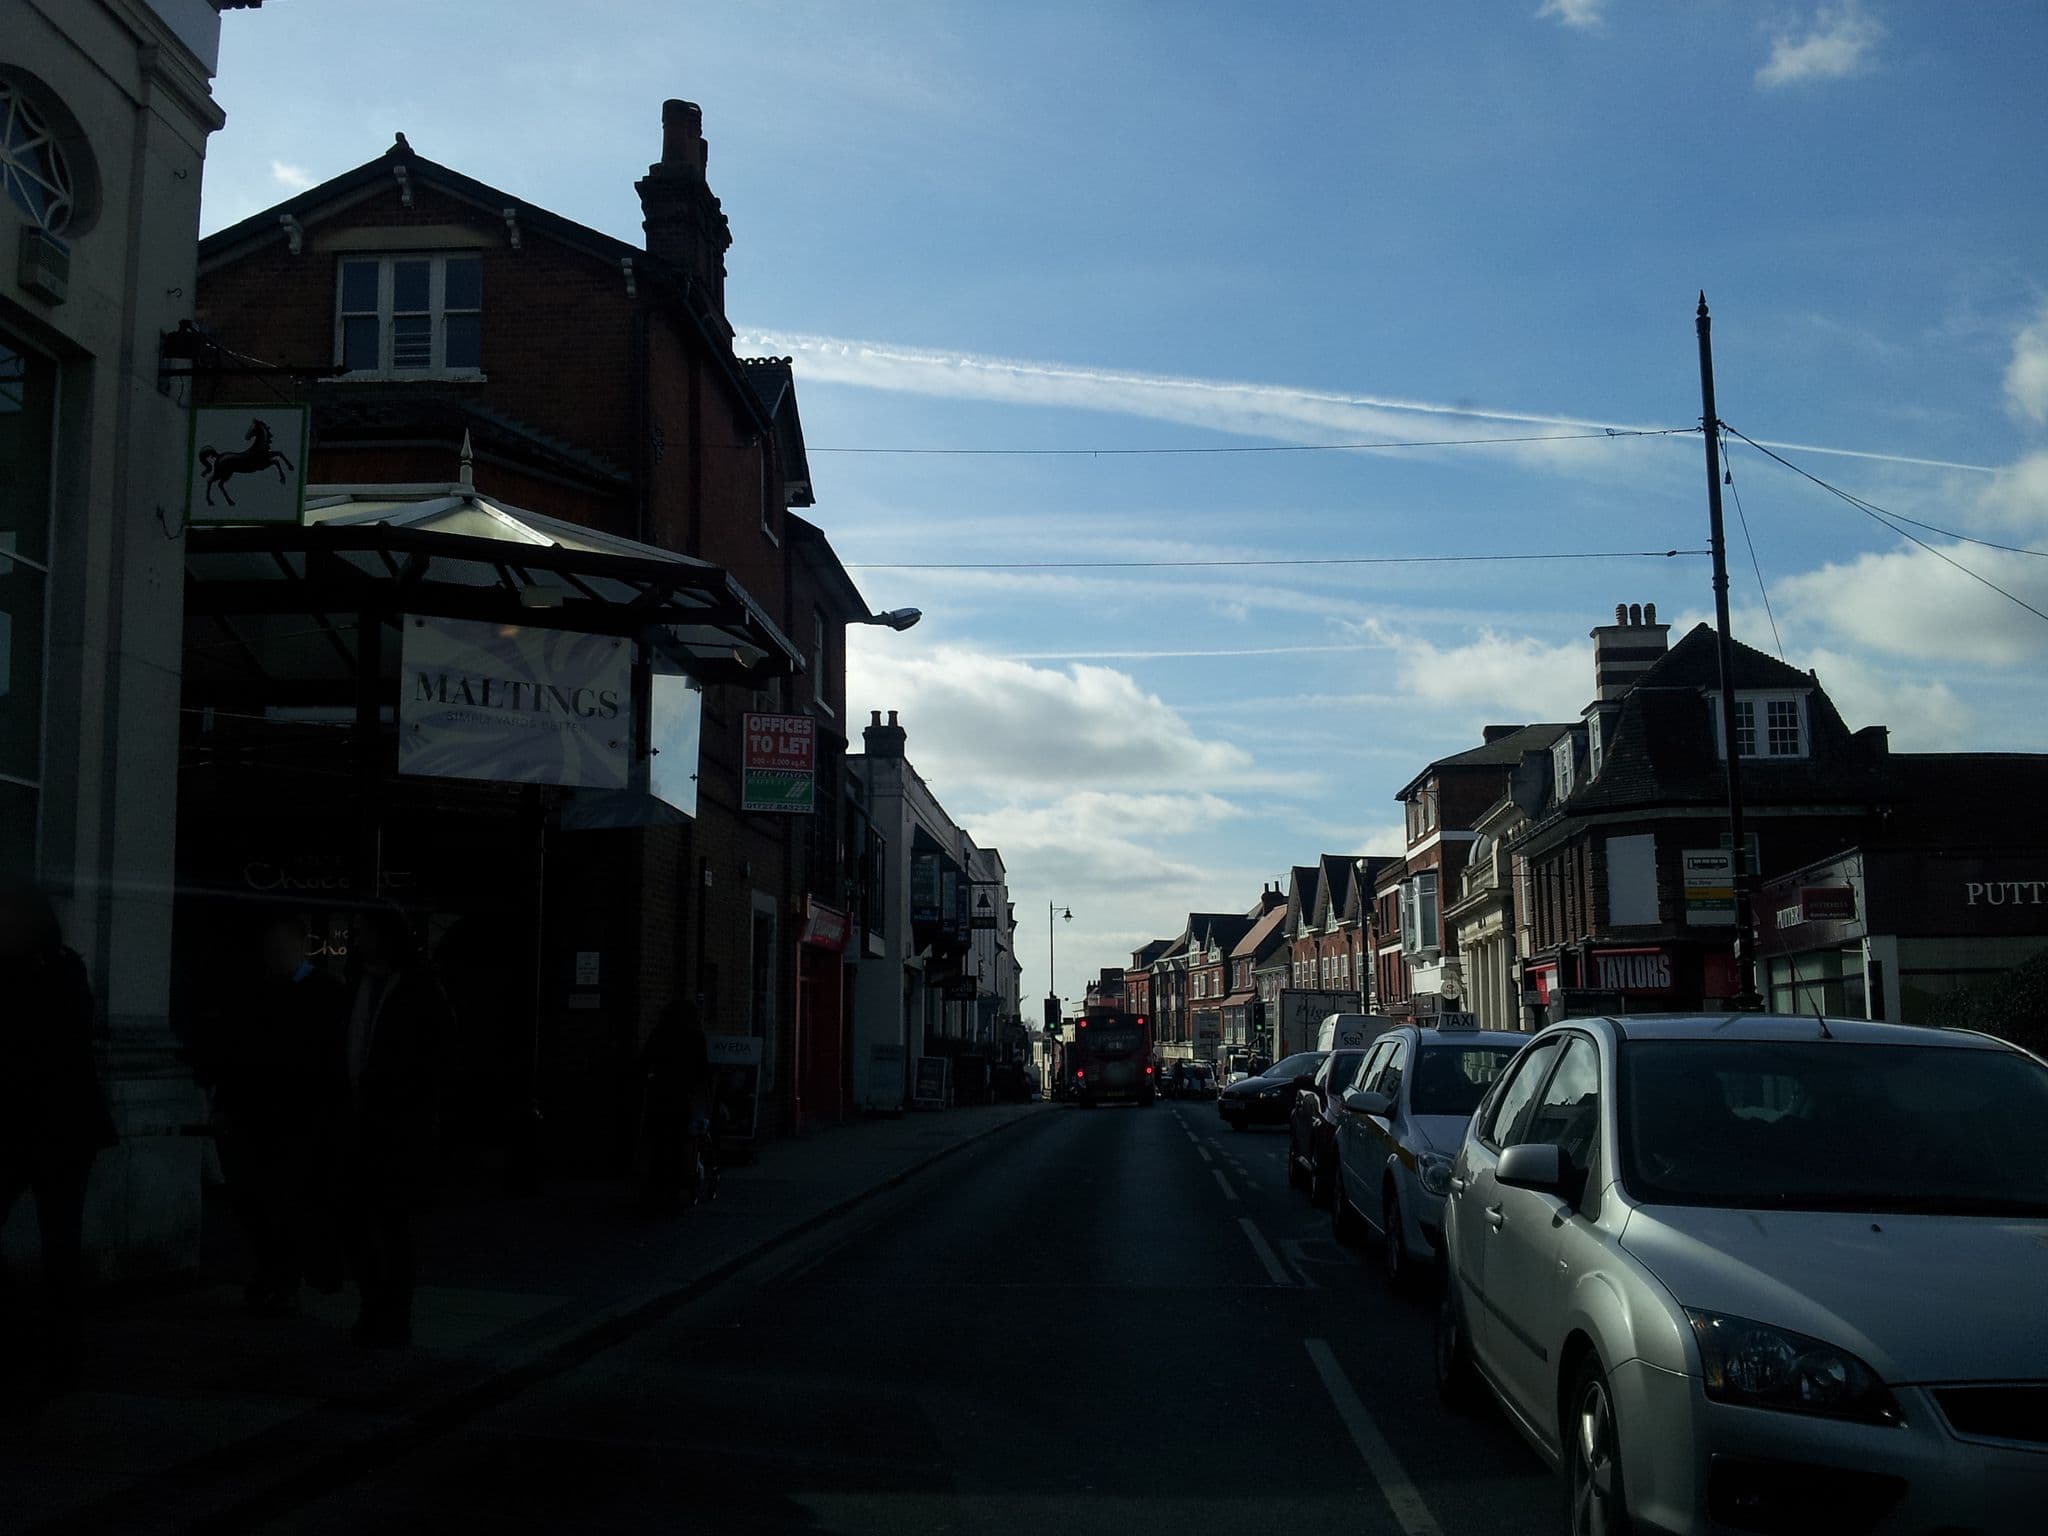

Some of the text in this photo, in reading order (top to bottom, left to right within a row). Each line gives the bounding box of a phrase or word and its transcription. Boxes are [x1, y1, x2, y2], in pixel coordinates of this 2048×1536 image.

[415, 671, 619, 720] MALTINGS
[750, 716, 811, 735] OFFICES
[750, 734, 811, 755] TO LET
[1965, 881, 2048, 906] PUTT
[1597, 954, 1673, 989] TAYLORS
[1444, 1013, 1474, 1027] TAXI
